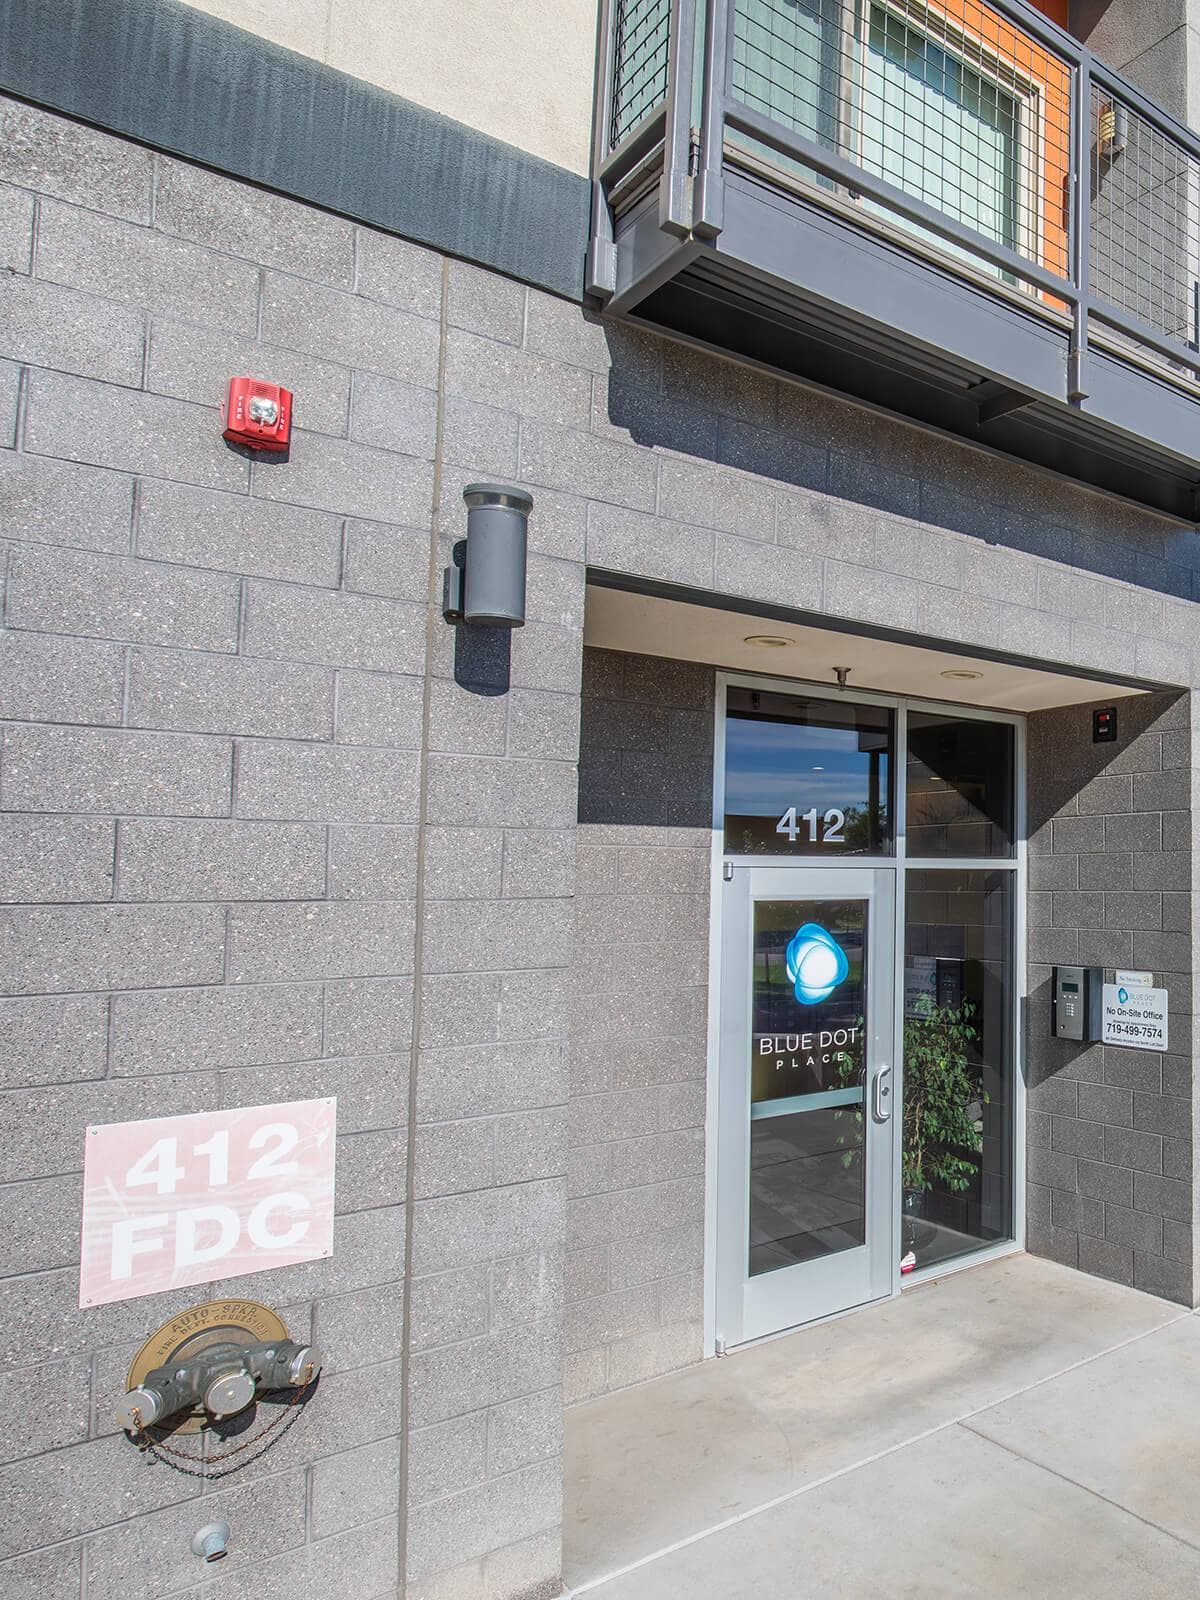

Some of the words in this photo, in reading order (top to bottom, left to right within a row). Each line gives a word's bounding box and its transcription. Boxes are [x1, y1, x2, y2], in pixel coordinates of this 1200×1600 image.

[236, 395, 244, 420] FIRE
[776, 807, 845, 842] 412
[1106, 1006, 1116, 1015] No
[1117, 1007, 1142, 1018] On-Site
[1143, 1010, 1163, 1020] Office
[760, 1033, 812, 1056] BLUE
[820, 1027, 859, 1048] DOT
[1106, 1022, 1162, 1039] 719-499-7574
[776, 1052, 845, 1070] PLACE
[125, 1122, 300, 1194] 412
[110, 1191, 311, 1280] FDC
